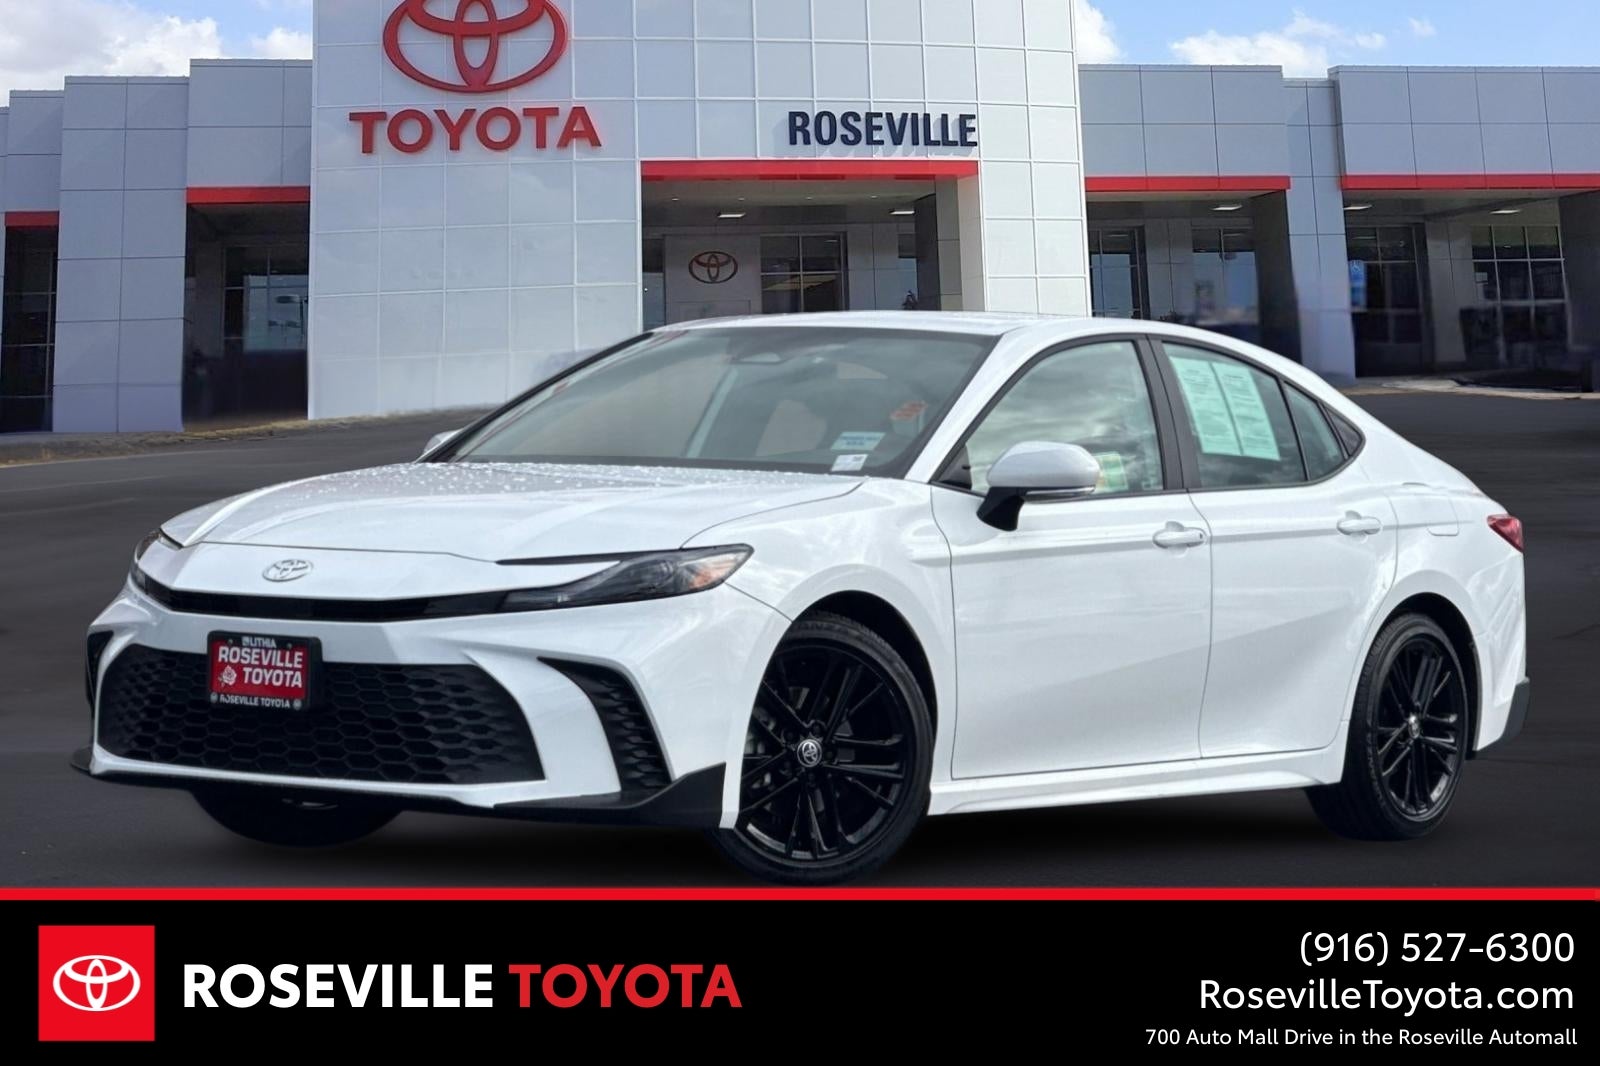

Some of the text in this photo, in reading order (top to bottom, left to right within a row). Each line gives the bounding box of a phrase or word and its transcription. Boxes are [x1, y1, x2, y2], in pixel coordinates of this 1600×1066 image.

[349, 106, 602, 154] TOYOTA
[788, 110, 978, 147] ROSEVILLE
[249, 636, 277, 649] LITHIA
[218, 645, 303, 669] ROSEVILLE
[243, 667, 303, 689] TOYOTA
[220, 694, 290, 709] ROSEVILLE TOYOTA
